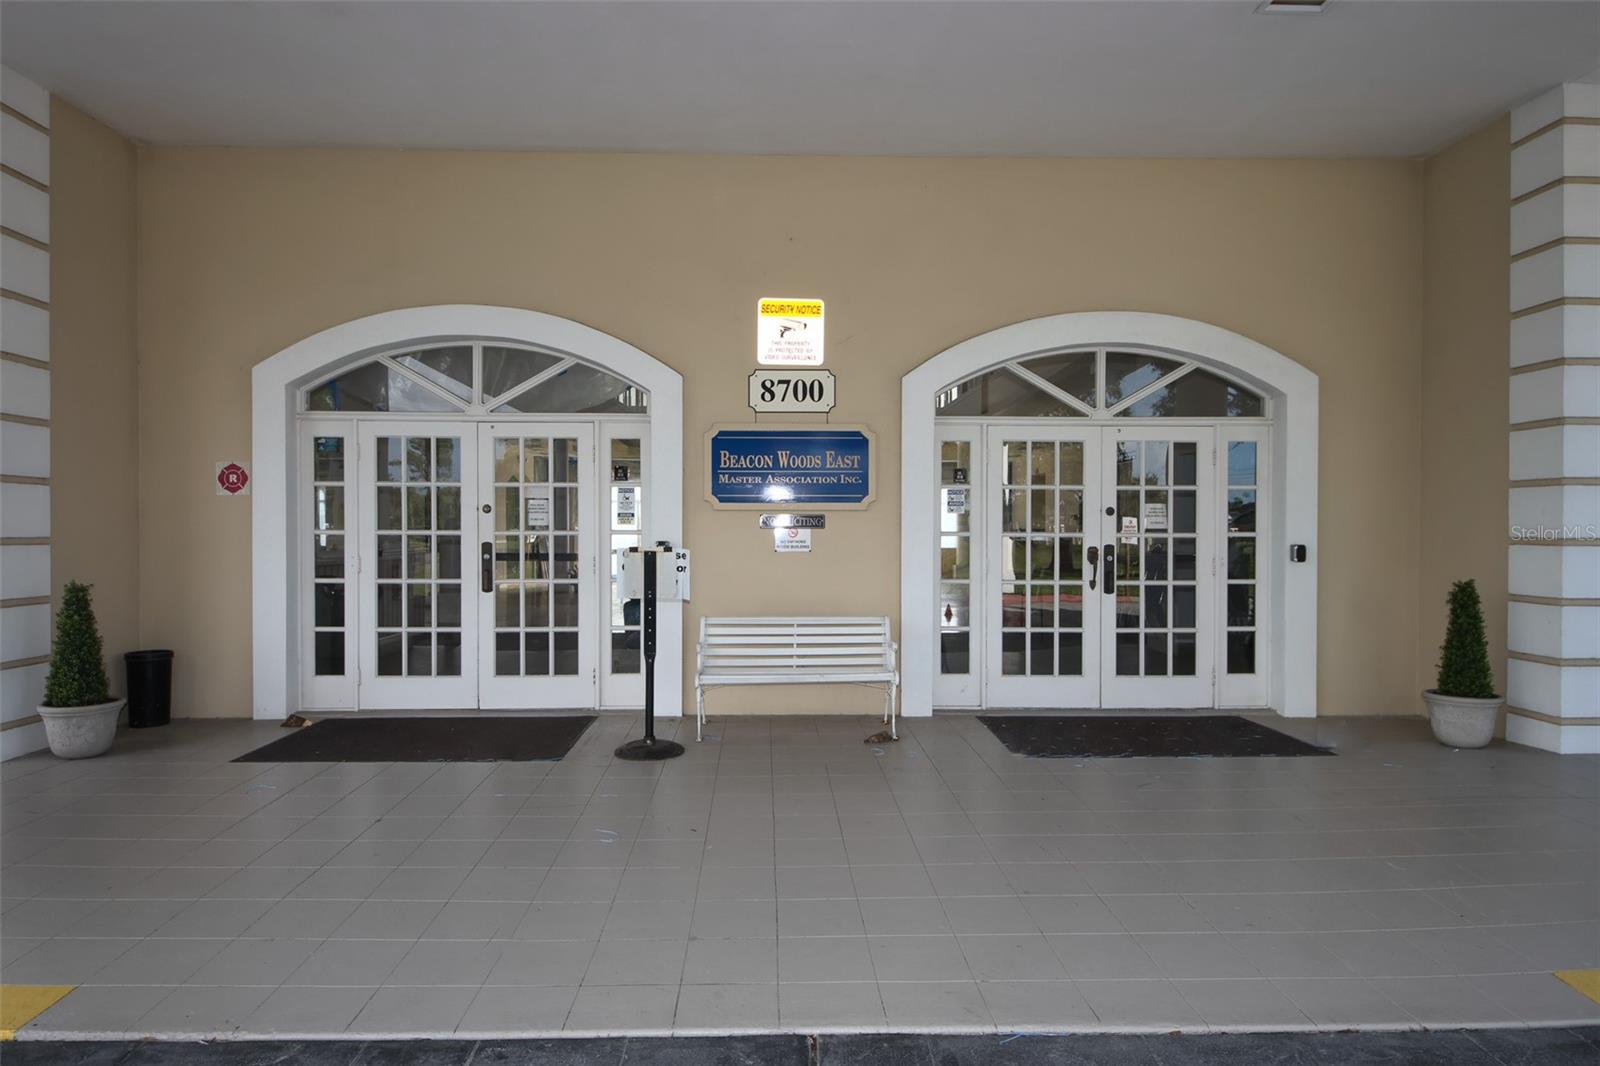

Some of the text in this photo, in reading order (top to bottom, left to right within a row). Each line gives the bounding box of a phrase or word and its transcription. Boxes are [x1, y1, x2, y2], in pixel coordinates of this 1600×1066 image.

[761, 304, 822, 315] SECURITY NOTICE
[760, 378, 824, 403] 8700
[719, 450, 861, 469] BEACON WOODS EAST
[229, 474, 238, 483] R
[718, 474, 862, 485] MASTER ASSOCIATION INC.
